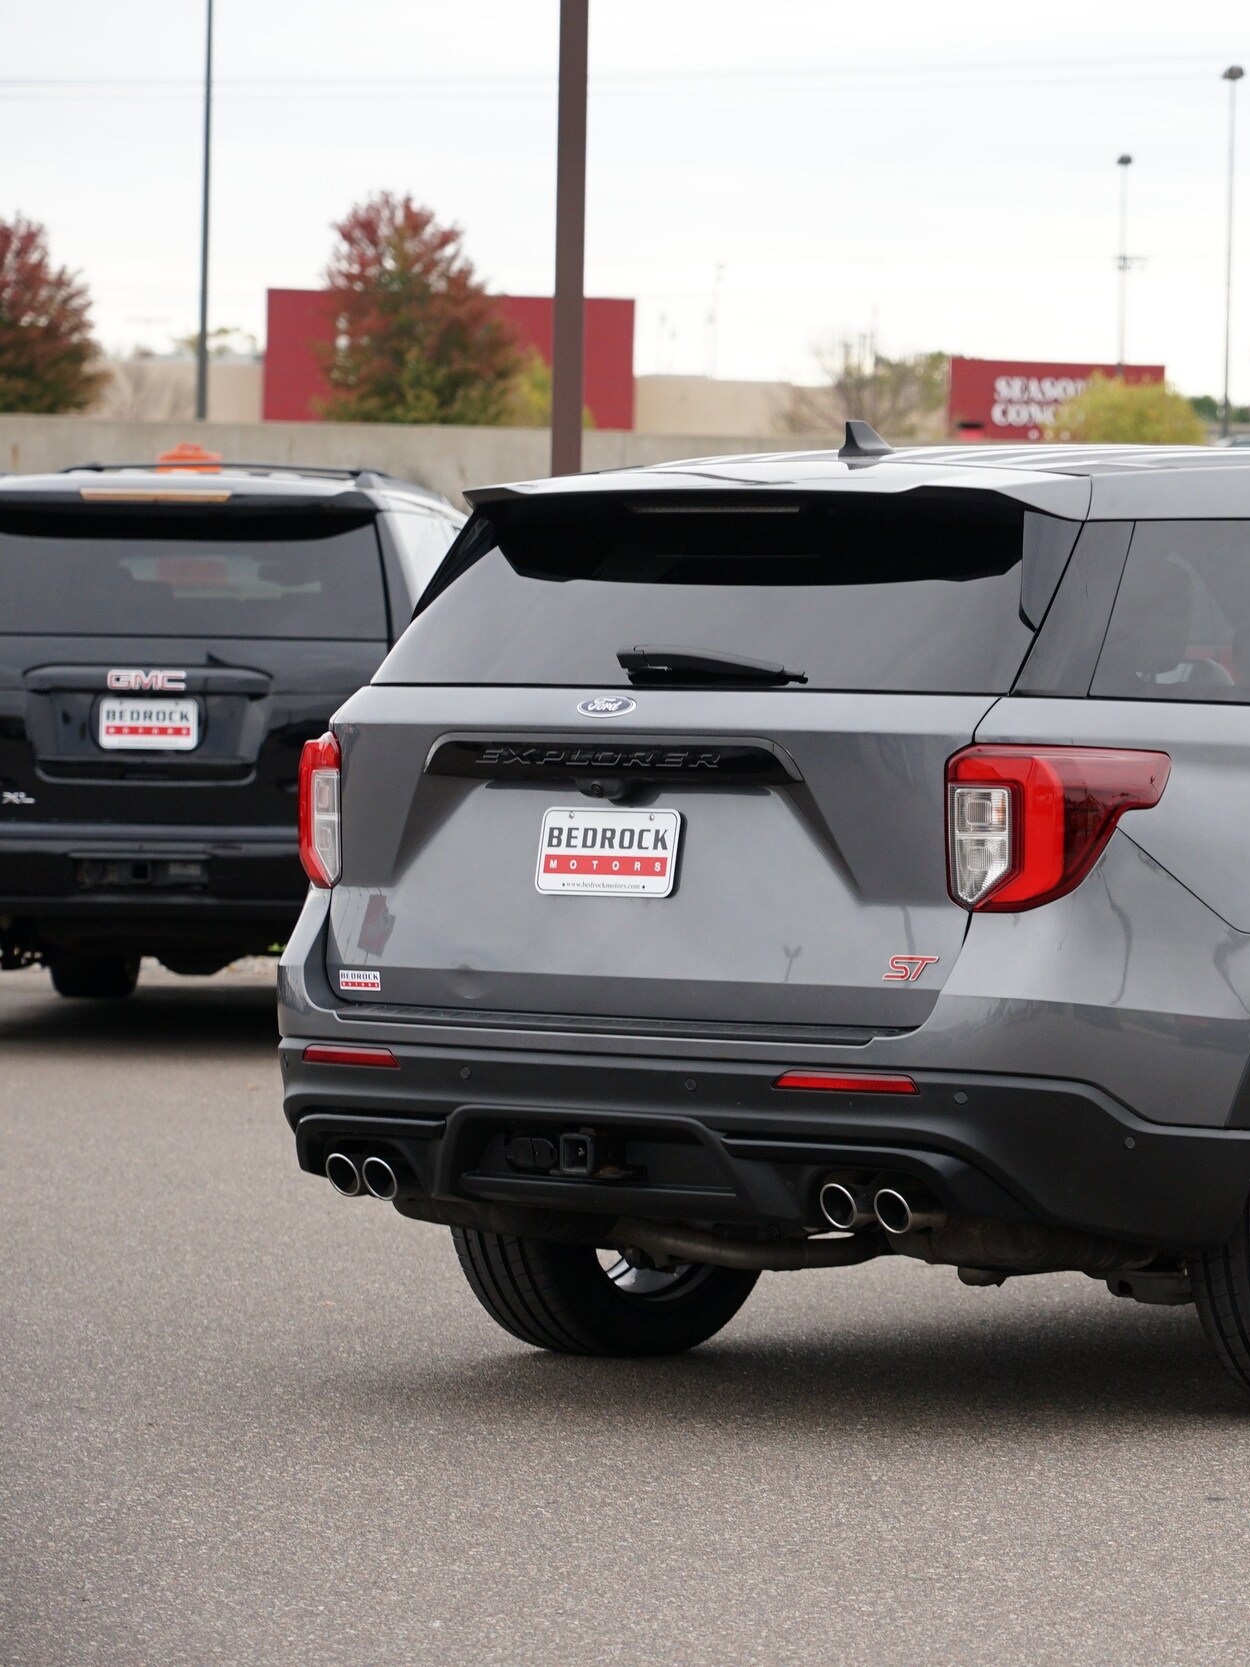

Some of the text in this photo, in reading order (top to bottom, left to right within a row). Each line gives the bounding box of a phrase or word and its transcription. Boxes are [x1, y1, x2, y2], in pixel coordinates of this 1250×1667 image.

[107, 669, 187, 691] GMC
[588, 698, 622, 712] Ford
[106, 710, 190, 722] BEDROCK
[475, 748, 721, 768] EXPLORER
[547, 826, 669, 851] BEDROCK
[549, 859, 661, 873] MOTORS
[882, 954, 939, 981] ST
[340, 972, 379, 981] BEDROCK
